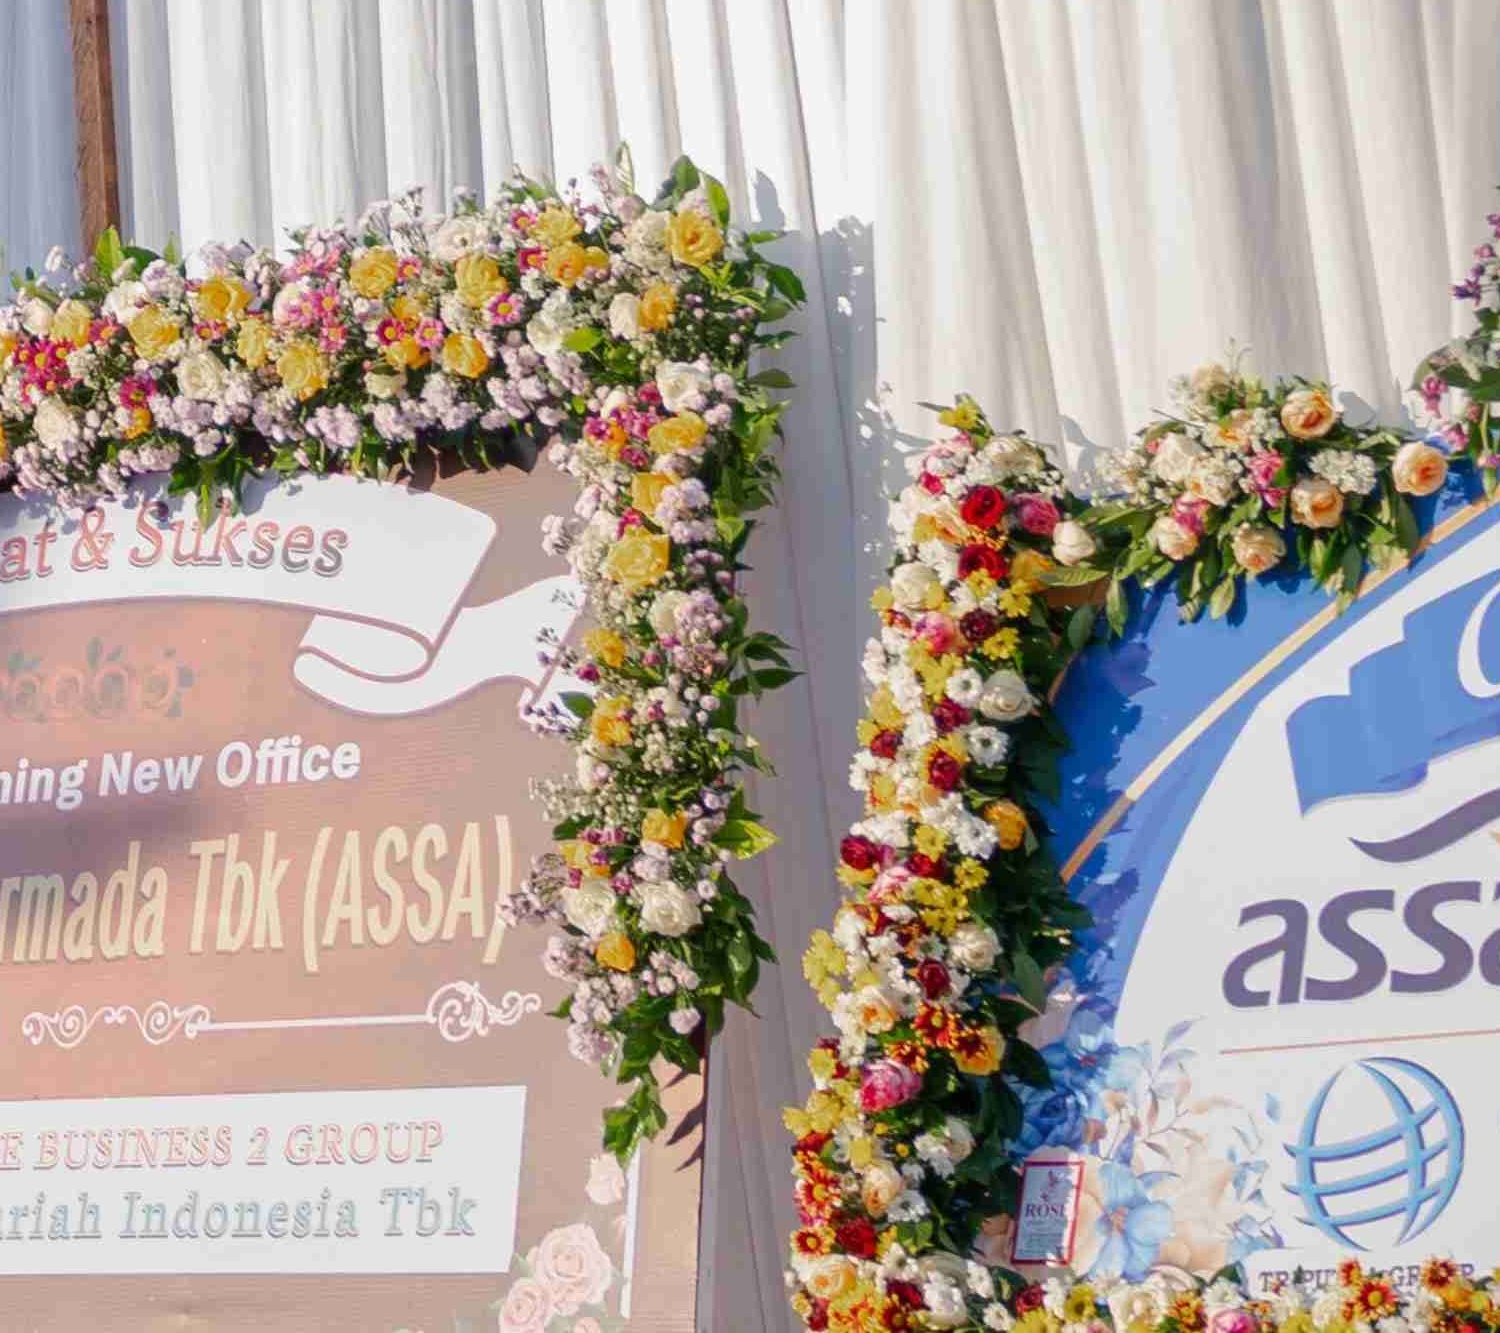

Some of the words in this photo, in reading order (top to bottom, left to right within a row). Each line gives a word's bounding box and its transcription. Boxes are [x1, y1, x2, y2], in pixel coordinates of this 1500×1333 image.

[69, 505, 116, 573] &
[127, 499, 350, 577] Sukses
[97, 750, 204, 794] New
[215, 734, 362, 790] Office
[186, 831, 294, 955] Tbk
[302, 814, 515, 974] (ASSA)
[32, 1126, 235, 1171] BUSINESS
[245, 1125, 270, 1166] 2
[284, 1119, 447, 1165] GROUP
[117, 1189, 360, 1241] Indonesia
[379, 1186, 479, 1238] Tbk
